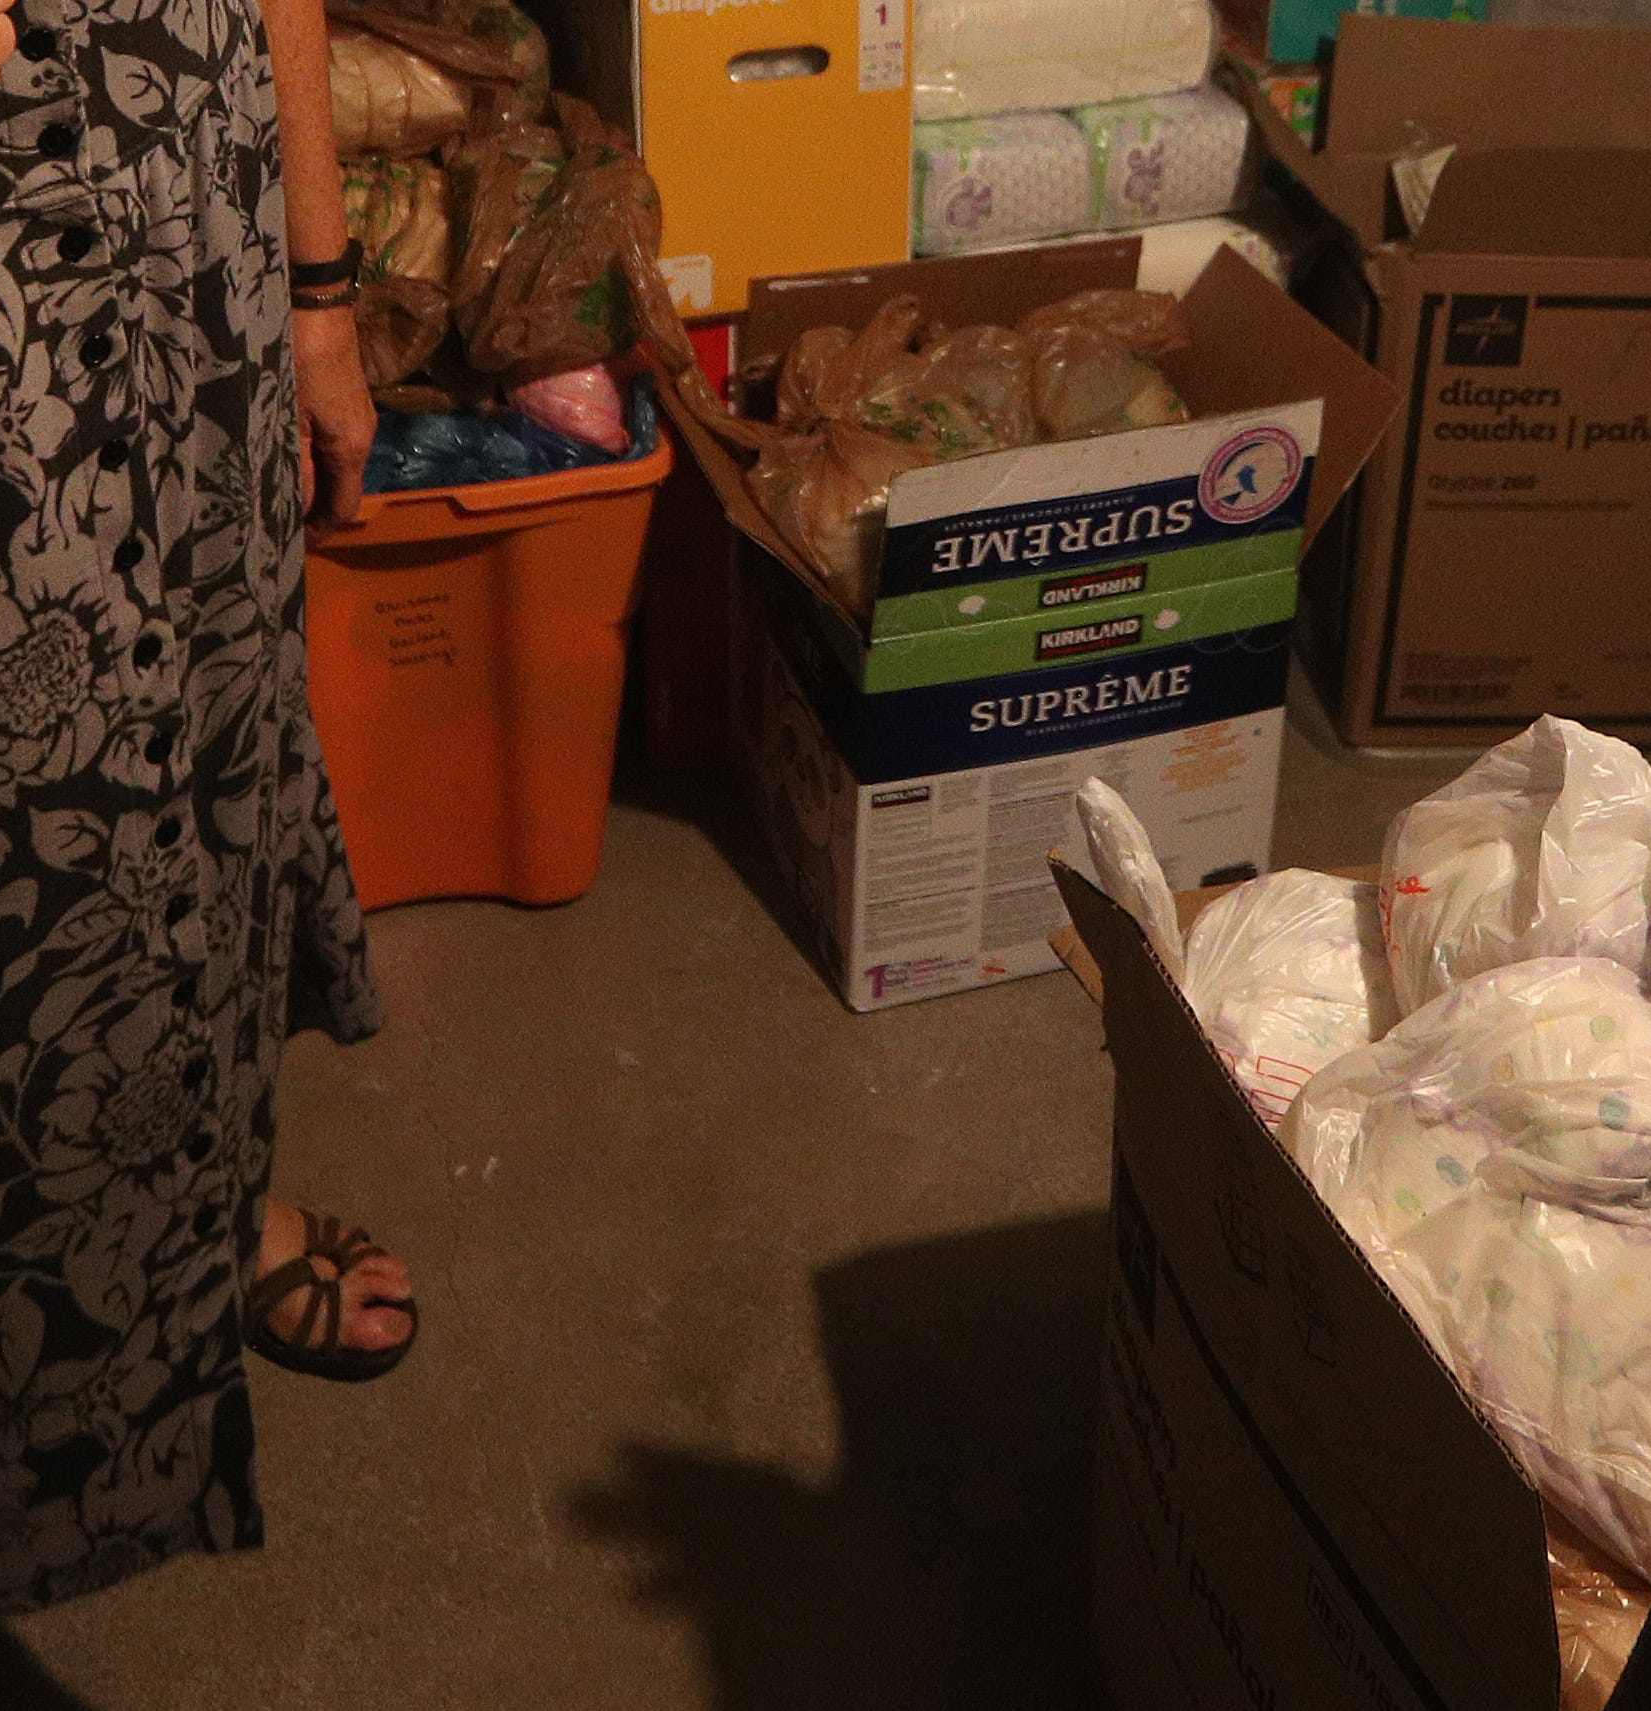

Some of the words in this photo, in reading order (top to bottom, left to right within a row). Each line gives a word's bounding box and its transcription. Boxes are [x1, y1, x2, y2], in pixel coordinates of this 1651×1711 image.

[1439, 378, 1562, 415] diapers
[1434, 413, 1556, 442] couches
[1042, 575, 1144, 607] KIRKLAND
[1041, 619, 1140, 649] KIRKLAND
[970, 664, 1193, 733] SUPRÊME
